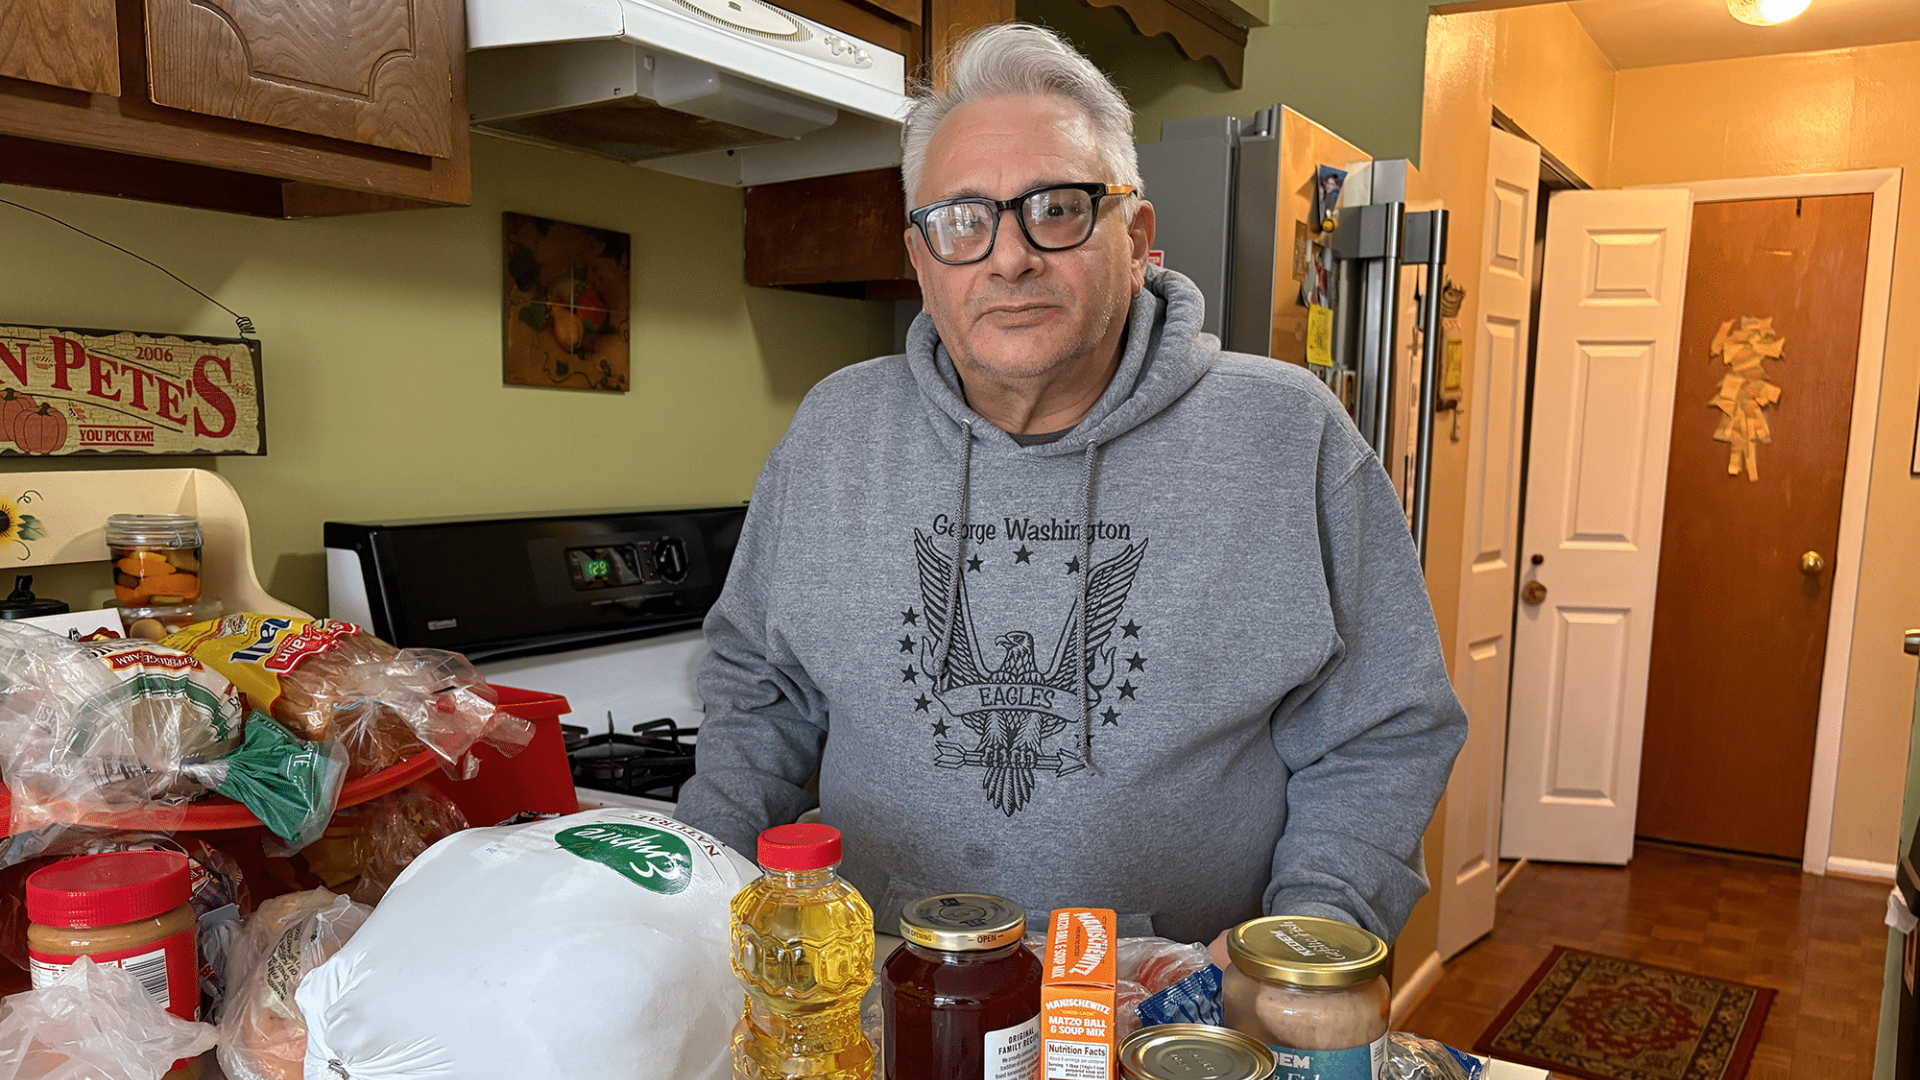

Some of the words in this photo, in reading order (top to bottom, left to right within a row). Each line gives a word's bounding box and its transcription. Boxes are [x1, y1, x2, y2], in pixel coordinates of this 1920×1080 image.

[135, 346, 174, 362] 2006
[49, 336, 237, 438] PETE'S
[79, 429, 103, 442] YOU
[105, 429, 132, 442] PICK
[134, 430, 155, 442] EM!
[933, 513, 996, 545] George
[1003, 517, 1131, 545] Washington
[979, 686, 1055, 709] EAGLES
[639, 814, 722, 858] NATURAL
[573, 828, 682, 881] Empire
[1056, 912, 1070, 931] MATZO
[977, 934, 997, 944] OPEN
[1054, 930, 1069, 945] BALL
[1068, 912, 1108, 976] MANISCHEWITZ
[1270, 929, 1317, 957] KEDEM
[1052, 949, 1067, 965] SOUP
[1051, 965, 1066, 979] MIX
[1046, 999, 1111, 1015] MANISCHEWITZ
[1049, 1016, 1082, 1026] MATZO
[1084, 1018, 1107, 1028] BALL
[1008, 1027, 1034, 1044] ORIGINAL
[1050, 1025, 1057, 1033] &
[1058, 1026, 1084, 1035] SOUP
[1086, 1028, 1106, 1037] MIX
[998, 1042, 1021, 1055] FAMILY
[1048, 1044, 1082, 1055] Nutrition
[1084, 1046, 1106, 1057] Facts
